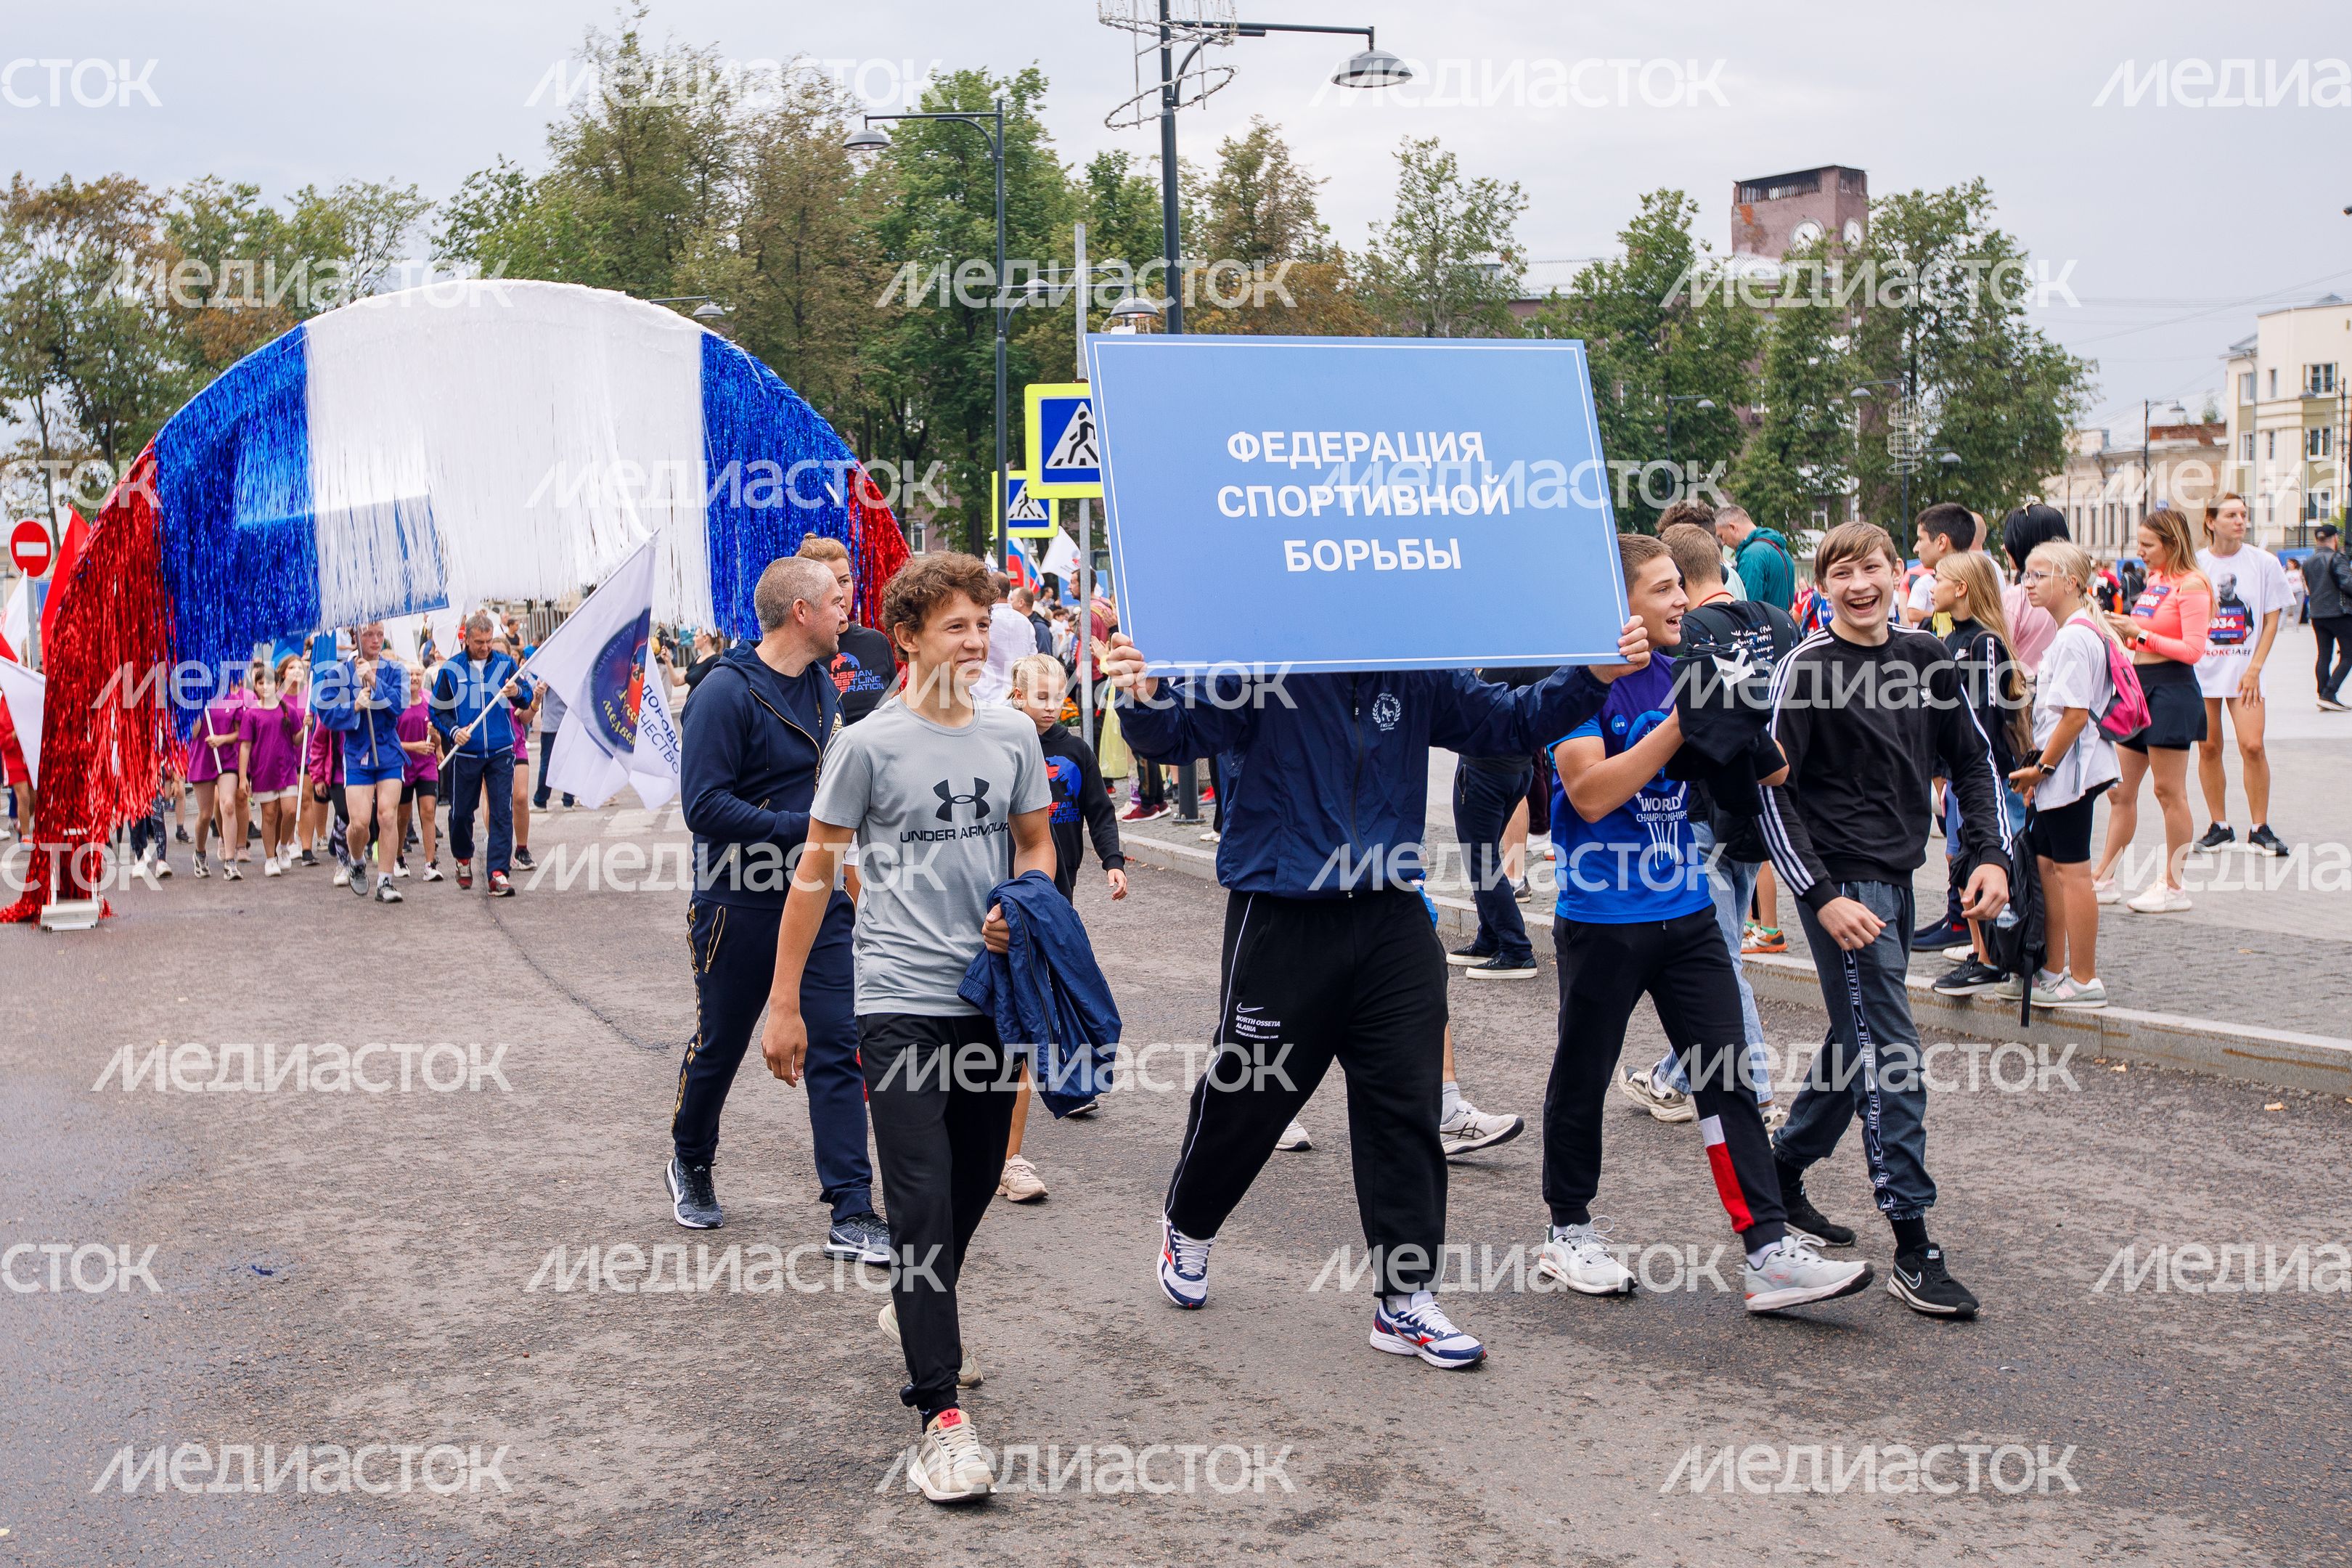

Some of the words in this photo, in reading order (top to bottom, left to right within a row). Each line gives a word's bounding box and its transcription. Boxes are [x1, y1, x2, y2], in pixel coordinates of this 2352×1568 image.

[1226, 430, 1485, 470] ФЕДЕРАЦИЯ
[1217, 474, 1511, 518] СПОРТИВНОЙ
[1283, 538, 1462, 571] БОРЬБЫ
[834, 675, 881, 687] ESTLING
[1641, 796, 1681, 812] WORLD
[900, 829, 956, 843] UNDER
[1847, 969, 1858, 984] AIR
[1850, 985, 1861, 1006] NIKE
[1236, 1015, 1256, 1025] NORTH
[1236, 1022, 1257, 1032] ALANIA
[1858, 1032, 1869, 1045] AIR
[1863, 1048, 1874, 1068] NIKE
[1869, 1094, 1879, 1108] AIR
[1869, 1109, 1879, 1130] NIKE
